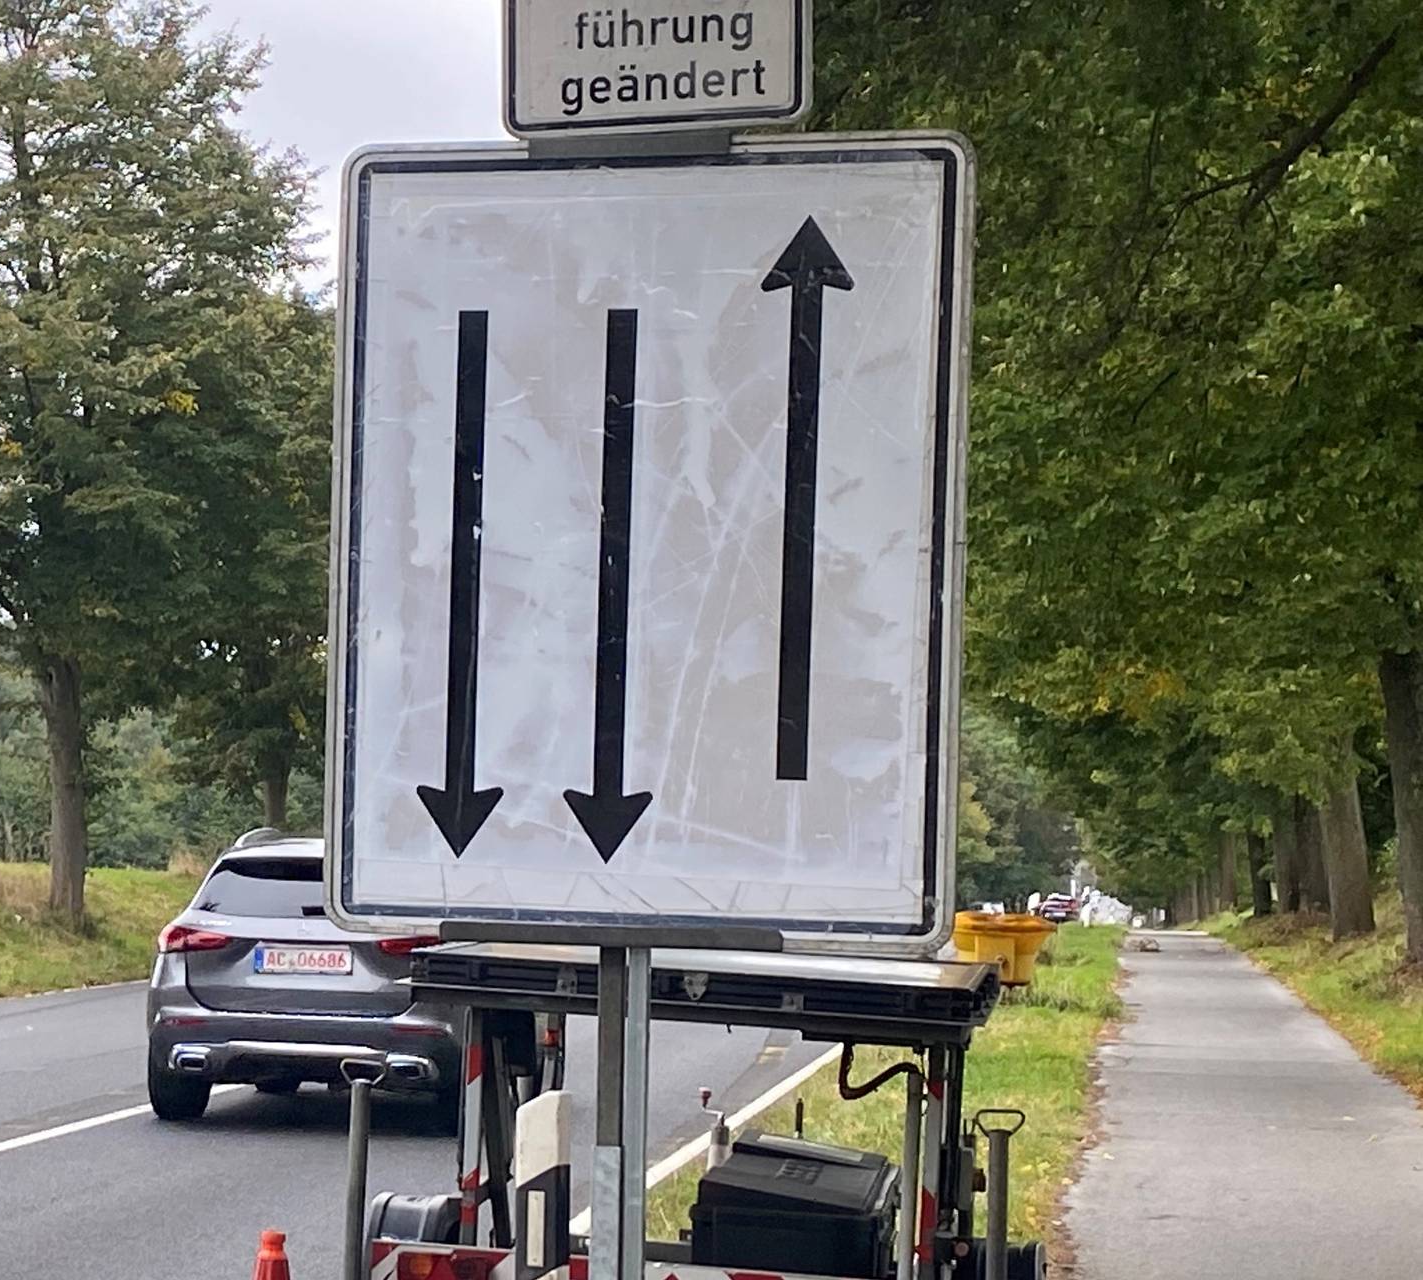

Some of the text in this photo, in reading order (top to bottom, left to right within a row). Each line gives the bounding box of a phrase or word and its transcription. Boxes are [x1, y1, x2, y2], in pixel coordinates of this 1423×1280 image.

[575, 9, 753, 51] führung
[561, 59, 766, 116] geändert
[266, 951, 287, 967] AC
